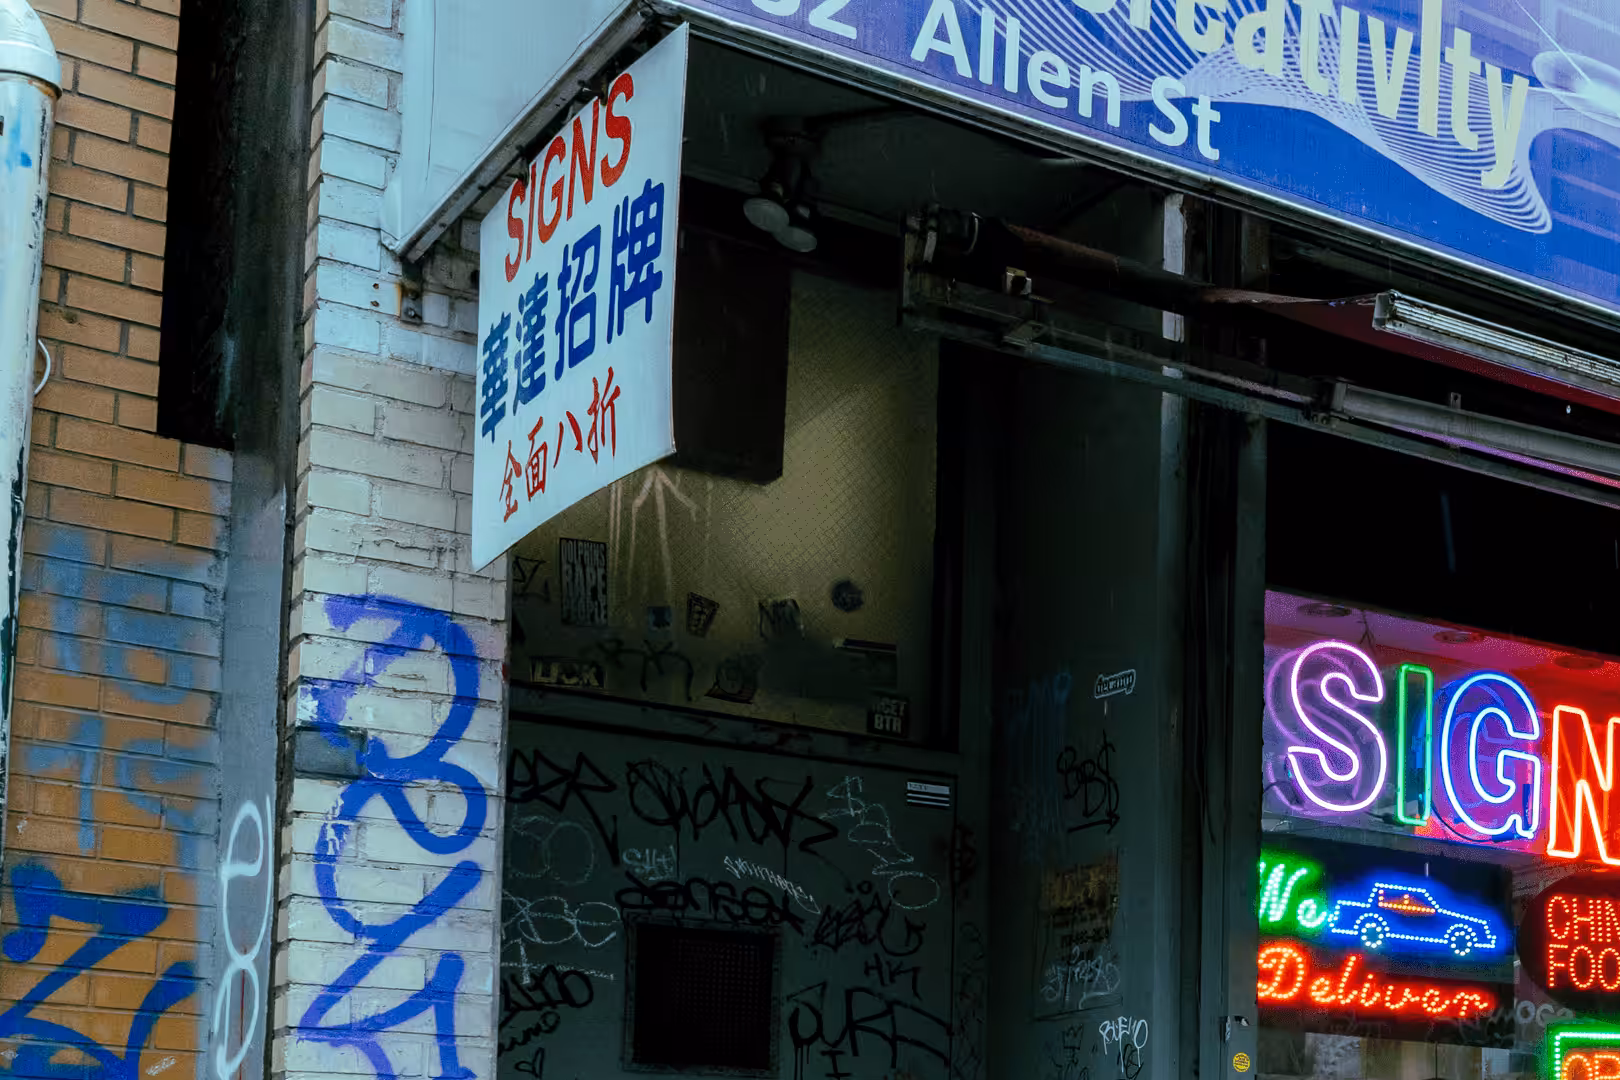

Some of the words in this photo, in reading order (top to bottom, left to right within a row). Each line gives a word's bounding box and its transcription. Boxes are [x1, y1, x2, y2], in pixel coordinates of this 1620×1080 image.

[911, 0, 1121, 128] Allen
[1148, 76, 1220, 161] St
[505, 73, 634, 283] SIGNS
[1258, 945, 1489, 1017] Deliver
